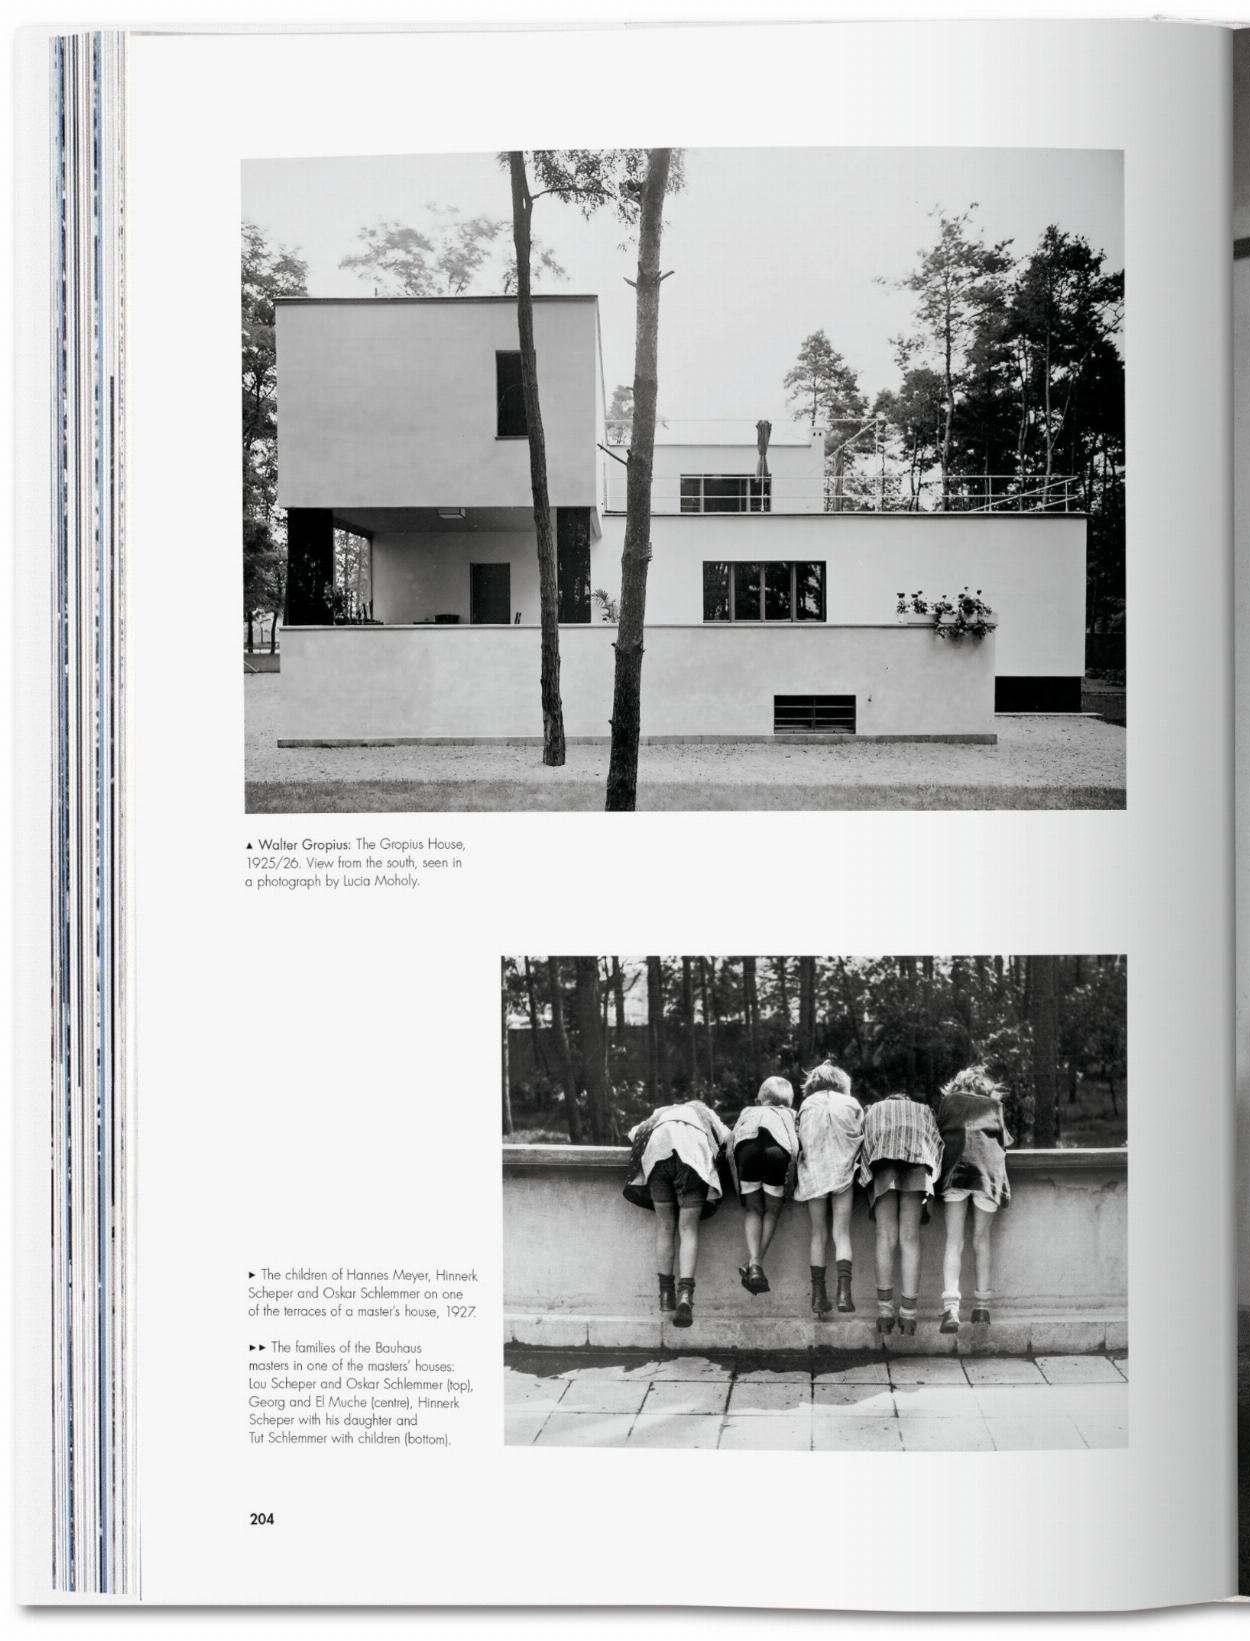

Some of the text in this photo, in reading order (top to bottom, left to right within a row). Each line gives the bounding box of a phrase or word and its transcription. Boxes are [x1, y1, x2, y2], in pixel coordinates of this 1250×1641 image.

[258, 837, 465, 853] Walter Gropius: The Gropius House,
[248, 855, 462, 870] 1925/26. View from the south, seen in
[245, 873, 420, 890] a photograph by Lucia Moholy.
[261, 1267, 478, 1284] The children of Hannes Meyer, Hinnerk
[248, 1286, 463, 1302] Scheper and Oskar Schlemmer on one
[248, 1304, 260, 1317] of
[263, 1304, 280, 1316] the
[284, 1307, 326, 1317] terraces
[330, 1304, 342, 1317] of
[345, 1309, 353, 1317] a
[405, 1304, 439, 1319] house,
[447, 1305, 476, 1318] 1927.
[271, 1340, 422, 1353] The families of the Bauhaus
[249, 1361, 289, 1371] masters
[293, 1361, 302, 1371] in
[307, 1363, 328, 1371] one
[332, 1358, 343, 1371] of
[347, 1358, 363, 1371] the
[416, 1359, 454, 1372] houses:
[249, 1376, 473, 1394] Lou Scheper and Oskar Schlemmer (top),
[248, 1394, 460, 1411] Georg and El Muche (centre), Hinnerk
[250, 1412, 418, 1429] Scheper with his daughter and
[249, 1431, 451, 1447] Tut Schlemmer with children (bottom).
[250, 1513, 275, 1525] 204
